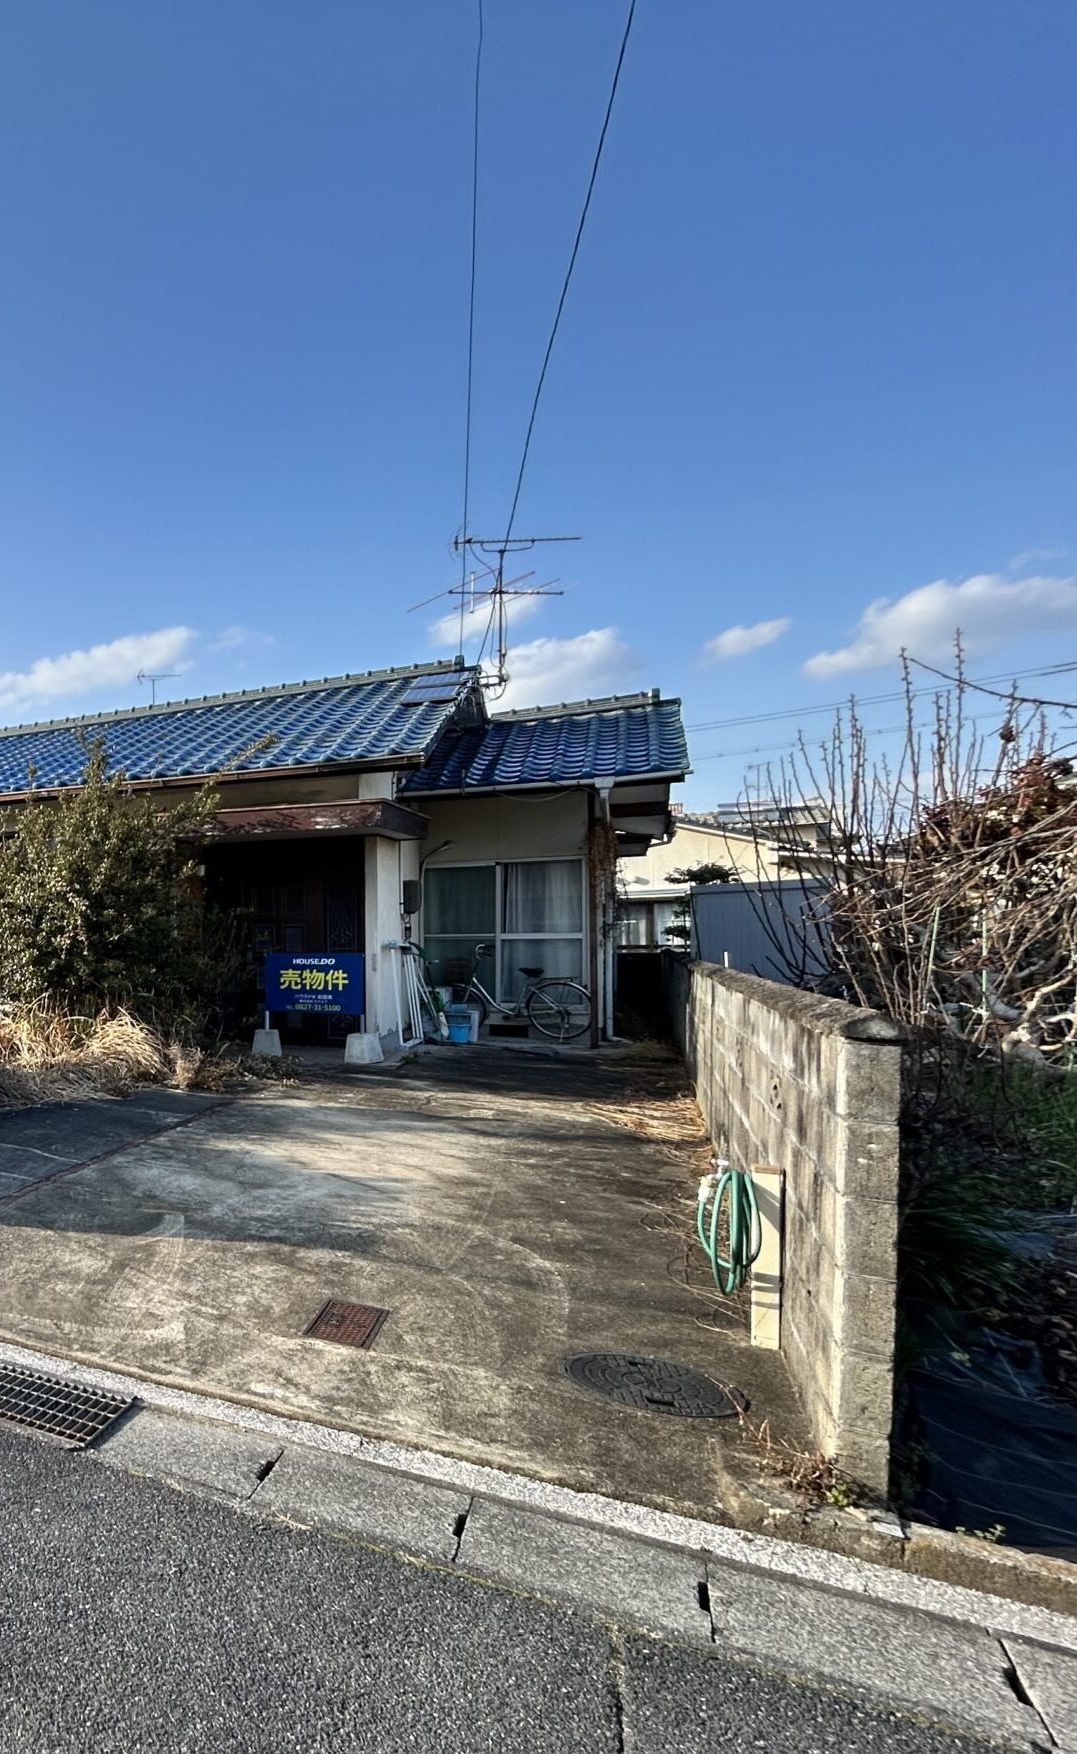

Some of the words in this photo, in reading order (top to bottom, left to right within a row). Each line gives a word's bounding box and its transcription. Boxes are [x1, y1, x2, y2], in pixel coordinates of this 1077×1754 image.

[280, 969, 349, 991] 売物件
[295, 1003, 341, 1012] 0827-31-5100
